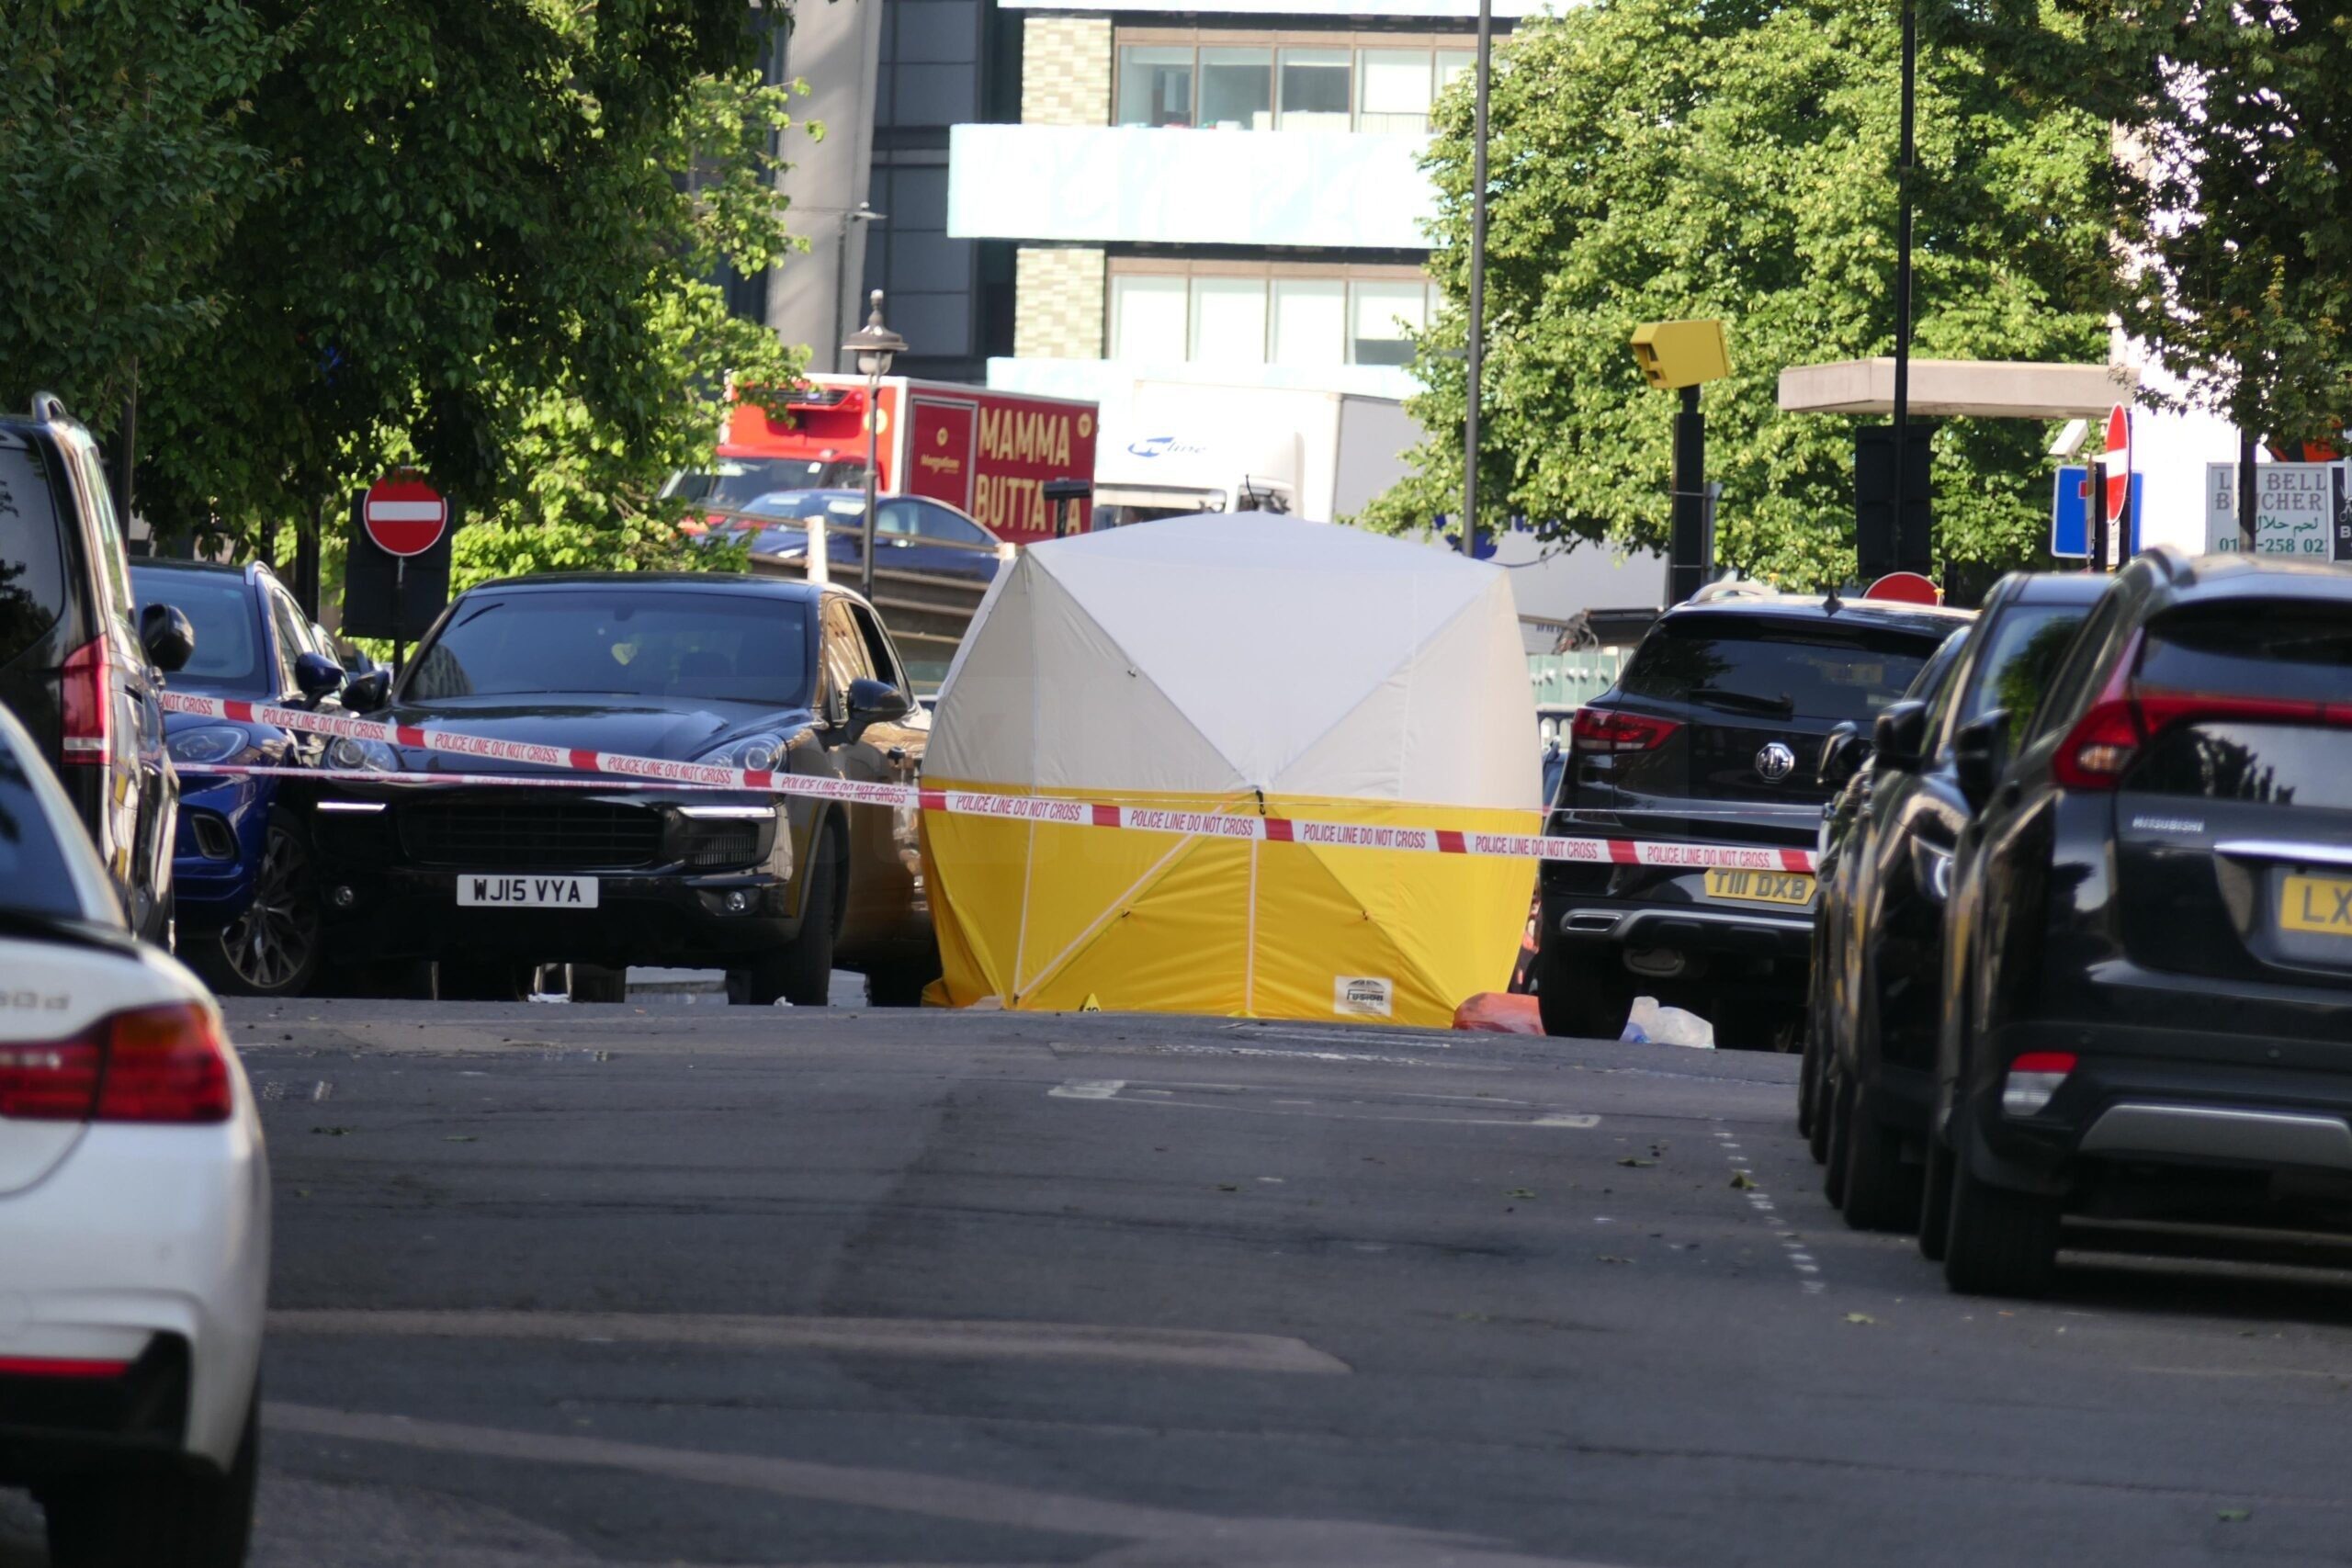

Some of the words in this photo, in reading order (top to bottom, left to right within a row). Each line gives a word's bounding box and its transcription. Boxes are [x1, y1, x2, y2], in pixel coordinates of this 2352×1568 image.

[978, 407, 1069, 467] MAMMA
[974, 474, 1046, 532] BUTTA
[2216, 492, 2323, 511] BCHER
[2220, 538, 2295, 552] 01-258
[163, 694, 183, 710] NOT
[185, 697, 213, 715] CROSS
[263, 708, 294, 726] POLICE
[297, 713, 316, 730] LINE
[320, 717, 332, 732] DO
[334, 719, 354, 735] NOT
[355, 722, 386, 740] CROSS
[435, 733, 466, 751] POLICE
[469, 737, 489, 753] LINE
[491, 740, 505, 756] DO
[507, 742, 526, 758] NOT
[526, 746, 559, 763] CROSS
[607, 757, 640, 773] POLICE
[642, 761, 662, 777] LINE
[664, 764, 678, 779] DO
[680, 767, 698, 781] NOT
[700, 770, 733, 784] CROSS
[956, 795, 989, 812] POLICE
[990, 798, 1012, 814] LINE
[1013, 801, 1029, 816] DO
[1030, 803, 1049, 818] NOT
[1049, 804, 1081, 820] CROSS
[1130, 810, 1163, 828] POLICE
[1164, 813, 1185, 829] LINE
[1187, 816, 1201, 831] DO
[1202, 817, 1222, 833] NOT
[1223, 818, 1254, 836] CROSS
[2132, 816, 2204, 832] MITSUBISHI
[1303, 824, 1335, 841] POLICE
[1338, 827, 1358, 843] LINE
[1360, 829, 1373, 845] DO
[1374, 829, 1394, 847] NOT
[1396, 830, 1426, 849] CROSS
[1476, 836, 1507, 853] POLICE
[1509, 838, 1530, 854] LINE
[1532, 840, 1545, 855] DO
[1547, 841, 1565, 857] NOT
[1567, 843, 1598, 859] CROSS
[1647, 846, 1679, 864] POLICE
[1681, 849, 1702, 865] LINE
[1704, 850, 1717, 865] DO
[1719, 851, 1737, 866] NOT
[1738, 852, 1770, 868] CROSS
[474, 879, 526, 901] WJ15
[535, 880, 581, 902] VYA
[1755, 874, 1807, 899] DXB
[2302, 885, 2352, 925] LX
